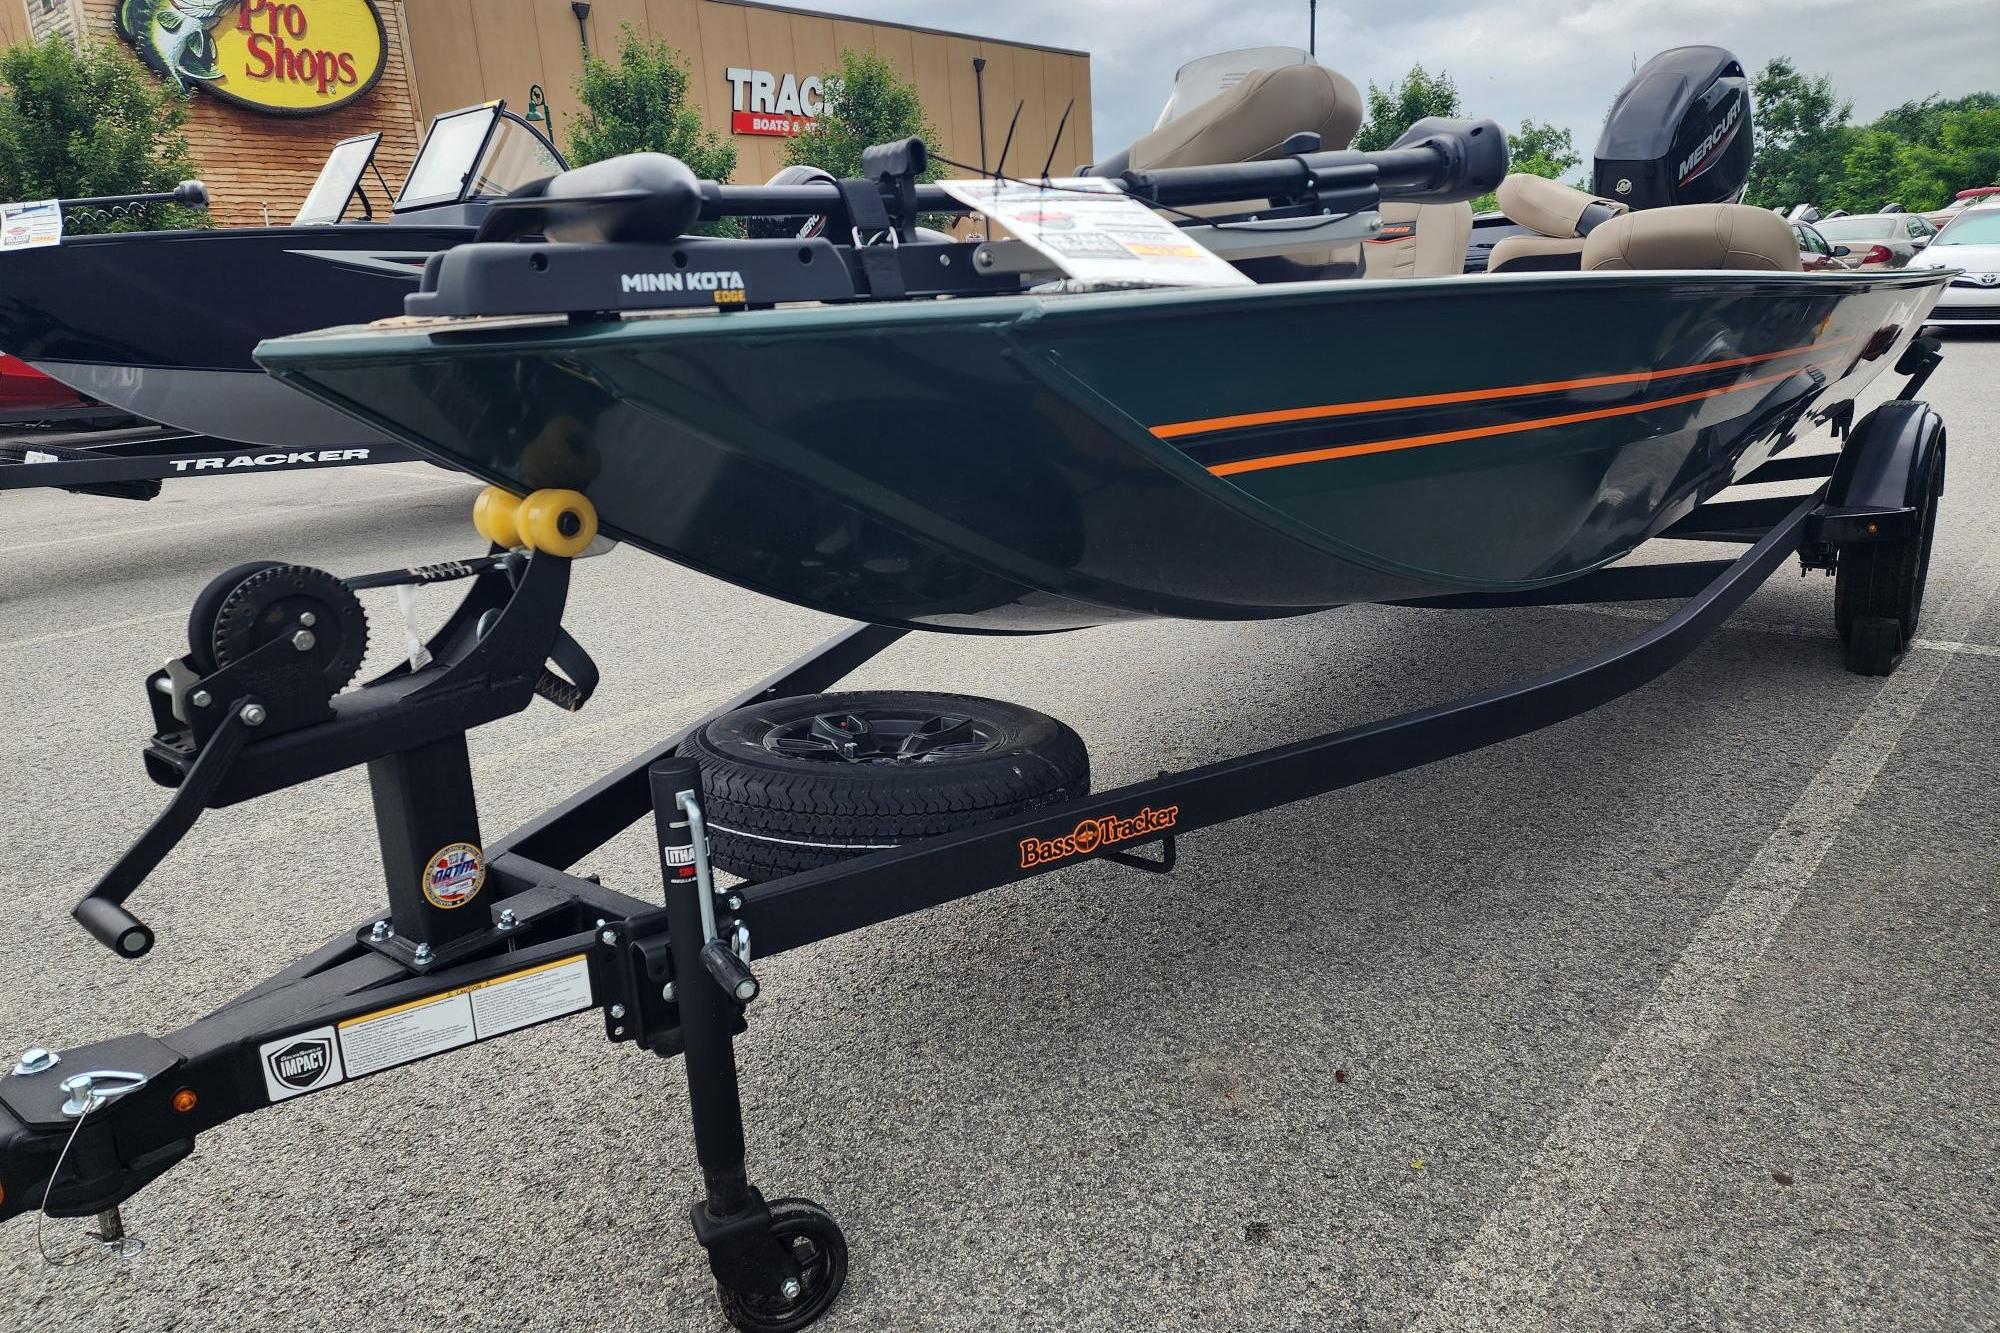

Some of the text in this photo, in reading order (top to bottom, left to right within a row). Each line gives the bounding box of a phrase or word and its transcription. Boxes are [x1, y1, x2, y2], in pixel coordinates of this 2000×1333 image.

[237, 0, 307, 37] Pro
[246, 33, 357, 94] Shops
[753, 118, 790, 132] BOATS
[1679, 91, 1743, 180] MERCURY
[621, 271, 745, 293] MINN KOTA
[713, 289, 746, 303] EDGE
[169, 448, 370, 471] TRACKER
[1020, 806, 1178, 868] Bass Tracker
[280, 1051, 324, 1078] IMPACT
